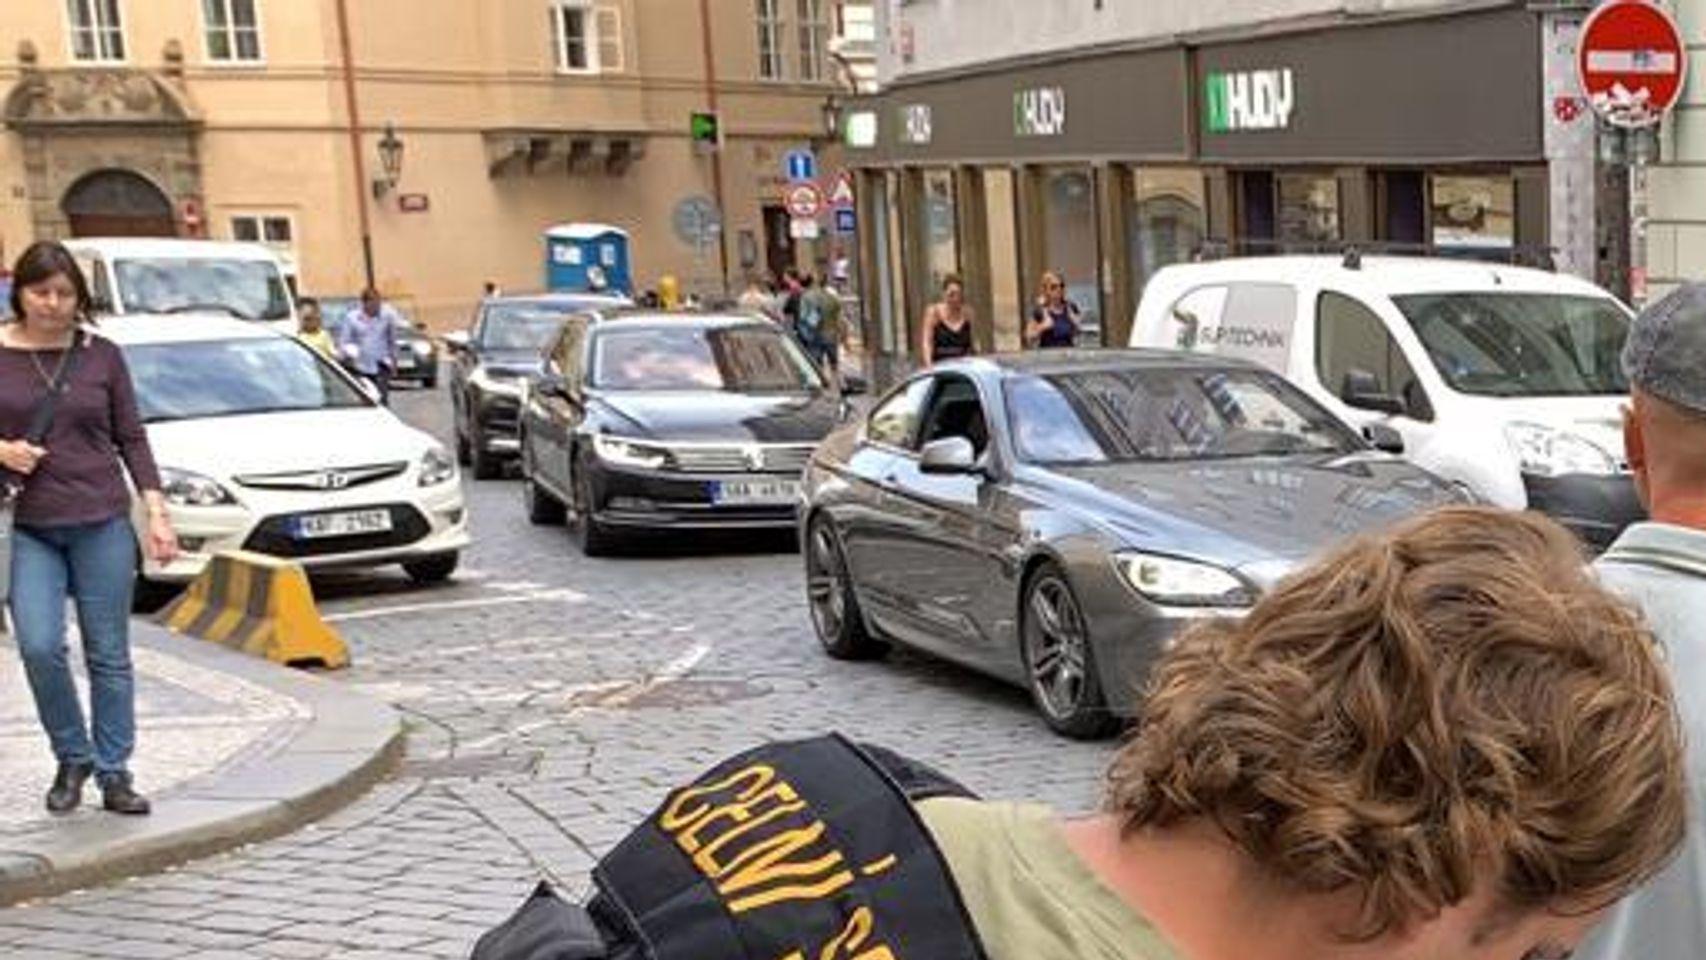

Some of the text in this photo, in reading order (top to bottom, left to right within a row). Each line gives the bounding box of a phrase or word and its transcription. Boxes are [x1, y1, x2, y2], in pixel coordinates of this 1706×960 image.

[1023, 87, 1066, 136] HUDY
[1226, 67, 1293, 129] HUDY
[660, 763, 896, 913] CELNÍ
